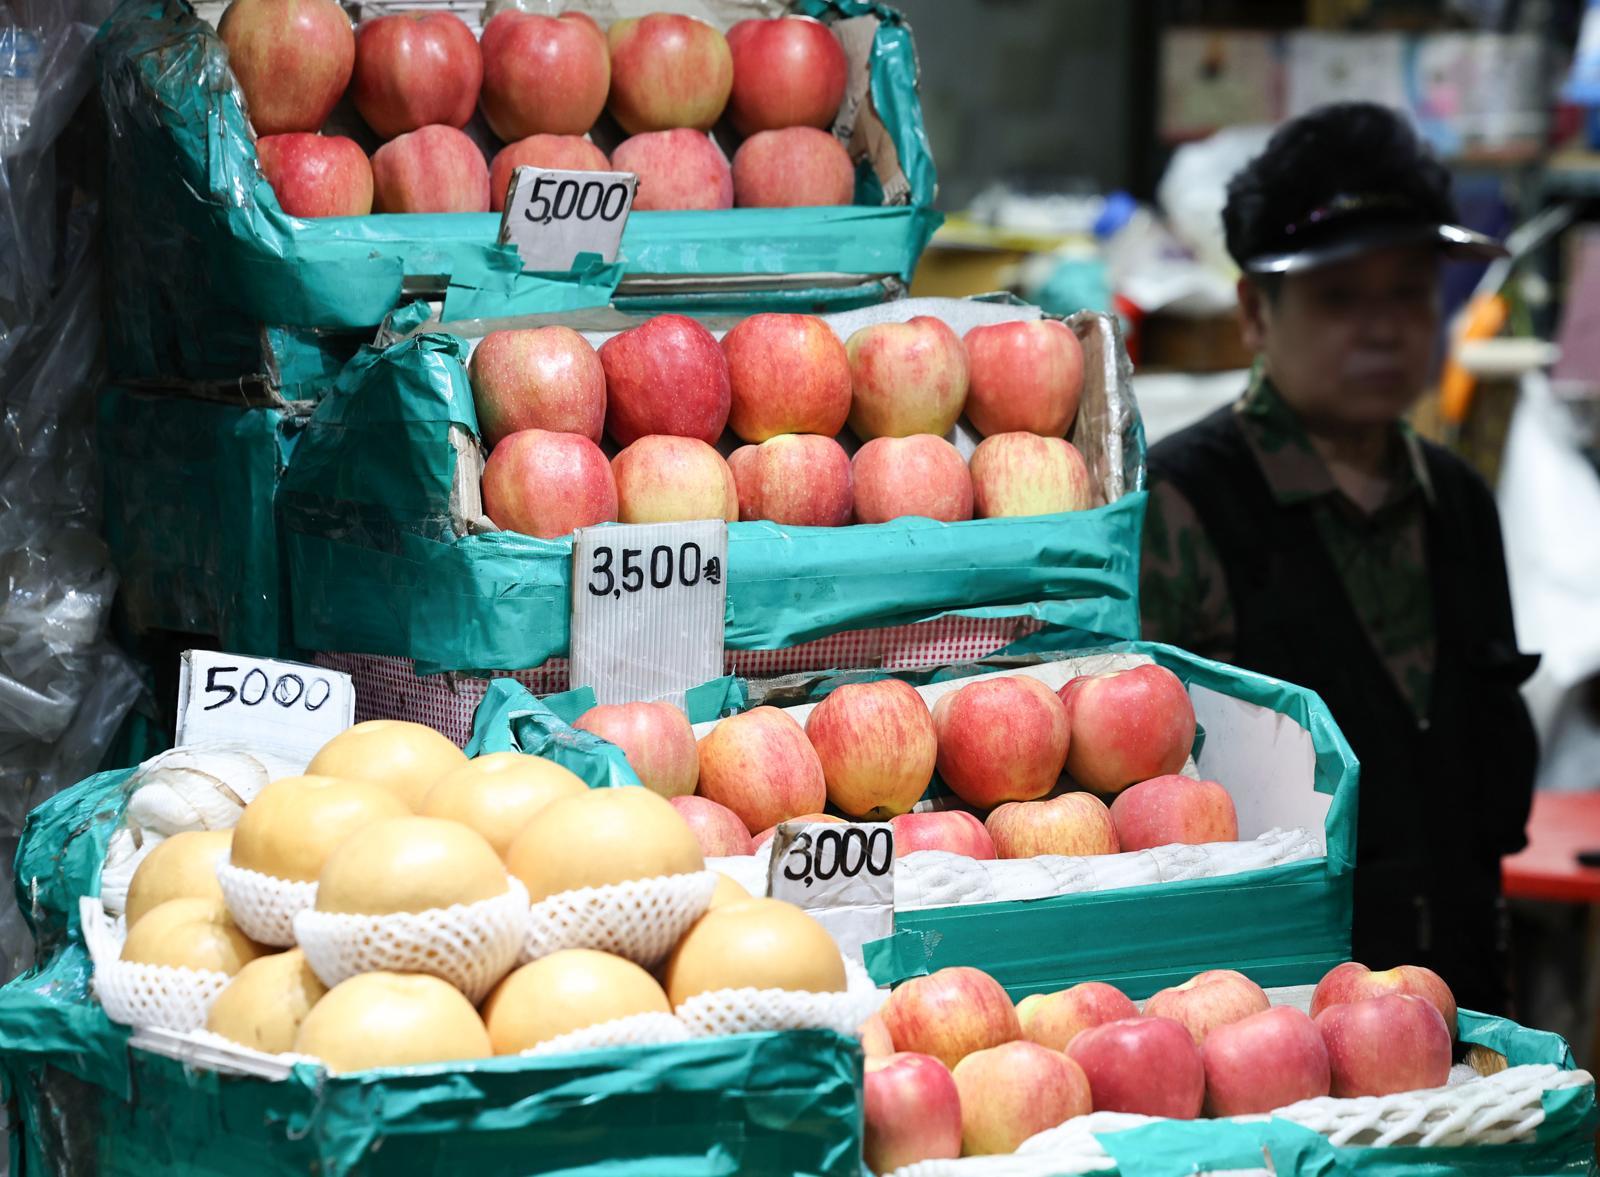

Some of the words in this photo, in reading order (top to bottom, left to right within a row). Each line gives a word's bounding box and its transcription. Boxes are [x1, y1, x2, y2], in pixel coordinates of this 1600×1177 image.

[525, 177, 628, 226] 5,000
[204, 666, 330, 711] 5000
[784, 828, 893, 888] 3,000
